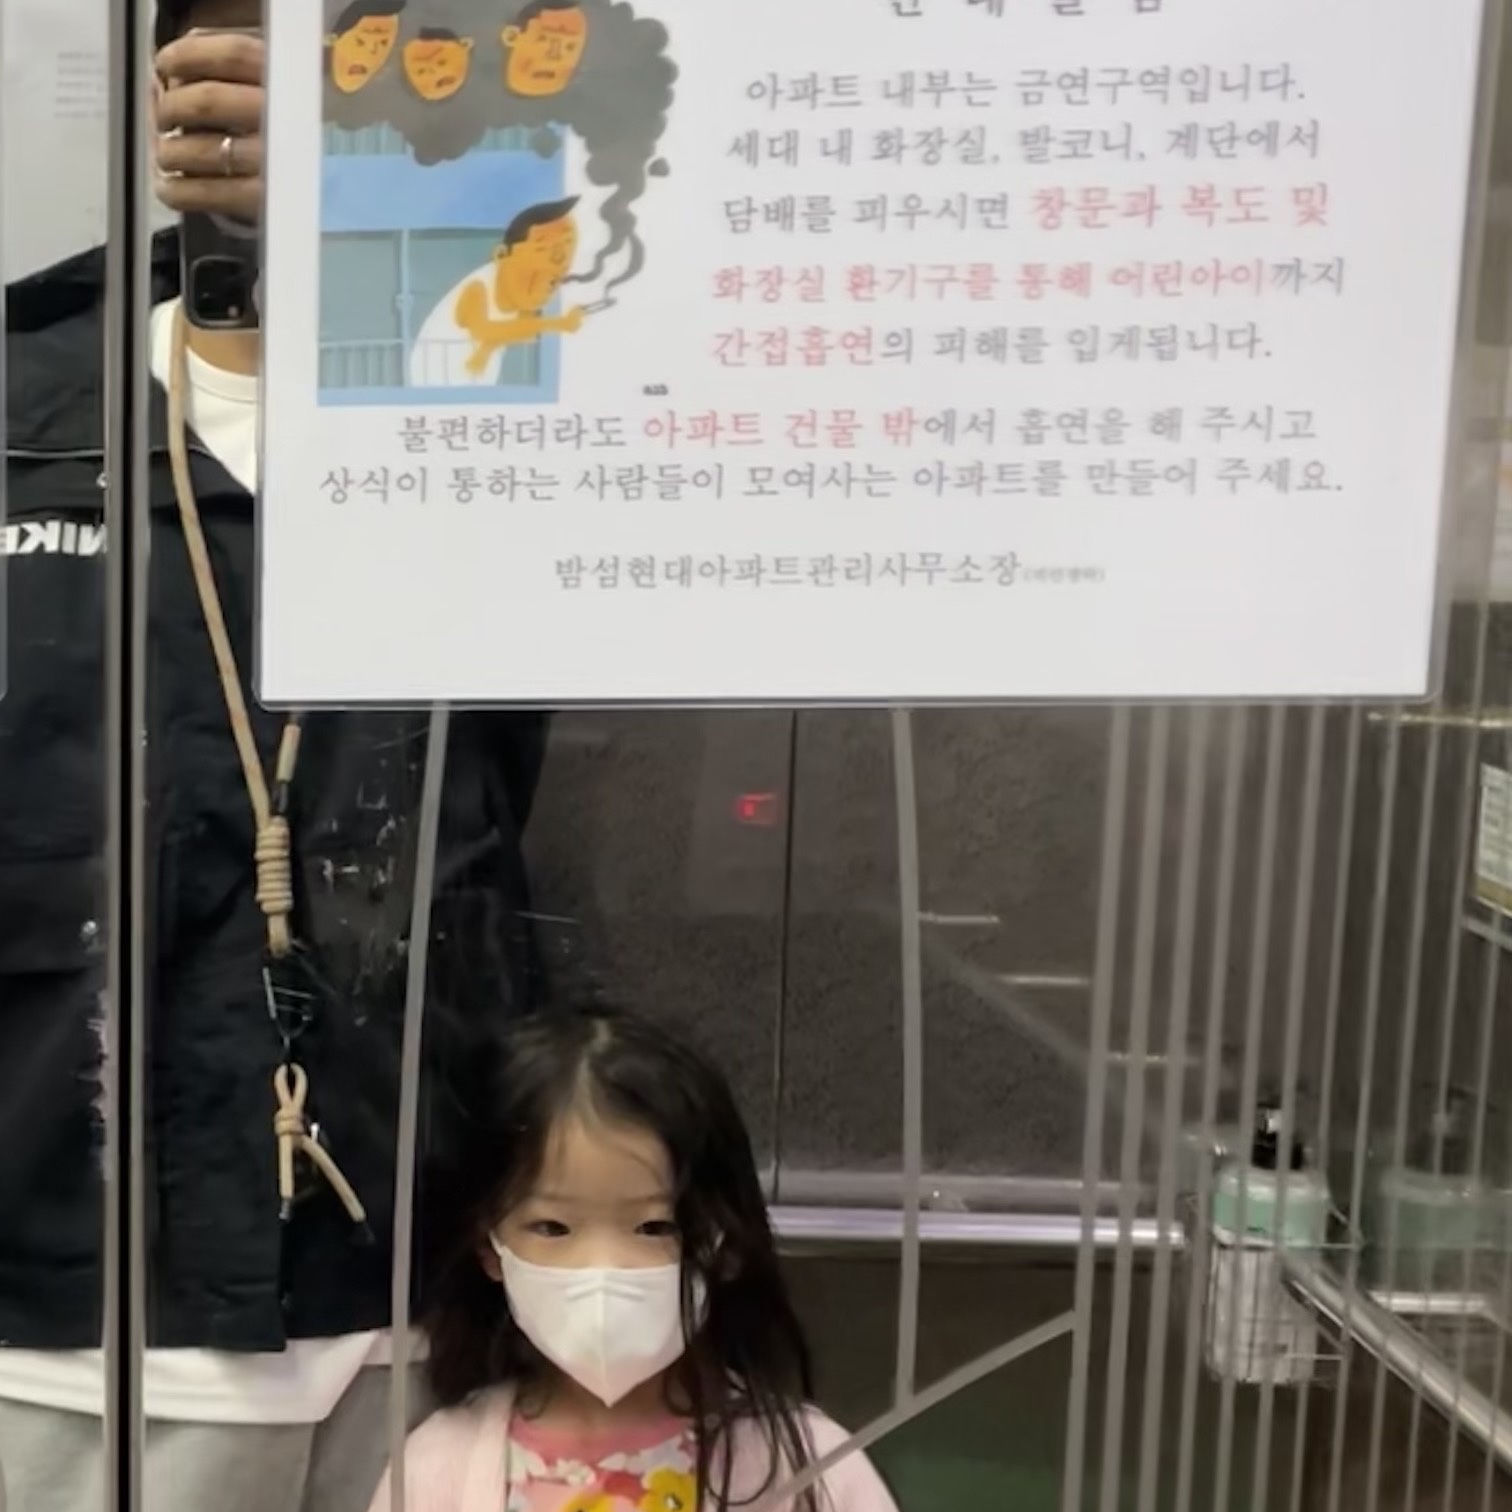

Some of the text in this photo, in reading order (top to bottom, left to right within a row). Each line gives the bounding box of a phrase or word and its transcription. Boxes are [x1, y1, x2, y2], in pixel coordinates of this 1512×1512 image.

[746, 63, 1306, 110] 아파트 내부는 금연구역입니다.
[728, 129, 800, 168] 세대
[819, 128, 854, 166] 내
[1167, 119, 1320, 159] 계단에서
[724, 183, 1328, 234] 담배를 피우시면 창문과 복도 및
[713, 257, 1345, 303] 화장실 환기구를 통해 어린아이까지
[714, 322, 1272, 367] 간접흡연의 피해를 입게됩니다.
[397, 404, 1318, 454] 불편하더라도 아파트 건물 밖에서 흡연을 해 주시고
[319, 456, 1344, 505] 상식이 통하는 사람들이 모여사는 아파트를 만들어 주세요.
[554, 551, 1023, 589] 밤섬현대아파트관리사무소장
